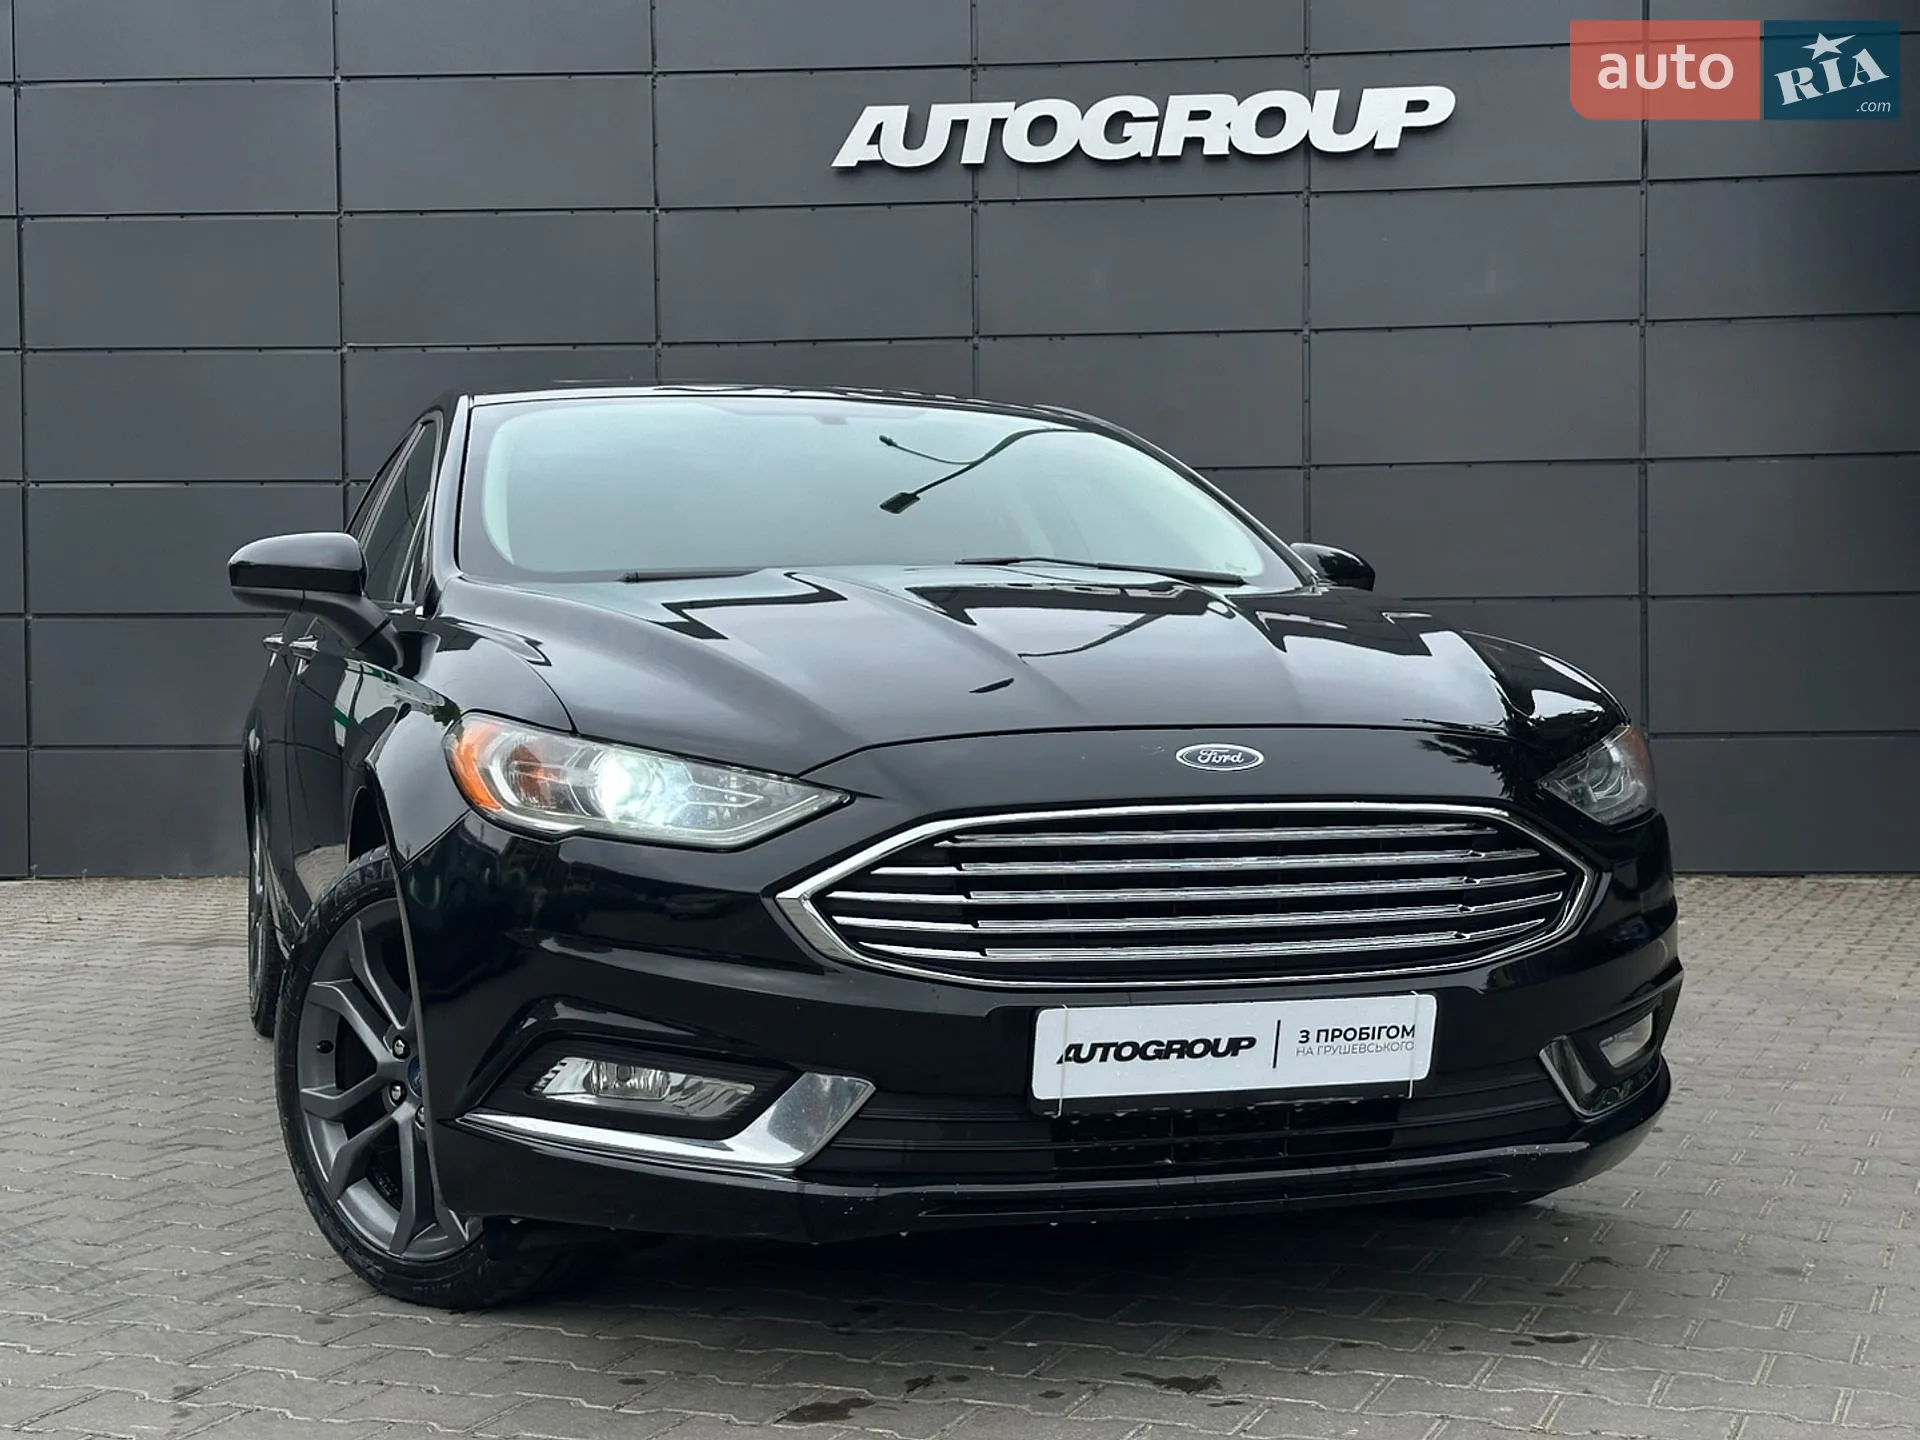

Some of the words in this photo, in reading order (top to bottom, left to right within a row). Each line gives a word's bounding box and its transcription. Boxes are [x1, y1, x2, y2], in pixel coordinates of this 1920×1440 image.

[832, 86, 1456, 168] AUTOGROUP
[1197, 749, 1244, 763] Ford
[1316, 1024, 1416, 1043] ПРОБІГОМ
[1056, 1036, 1257, 1064] AUTOGROUP
[1296, 1046, 1314, 1056] НА
[1317, 1041, 1415, 1056] ГРУШЕВСЬКОГО
